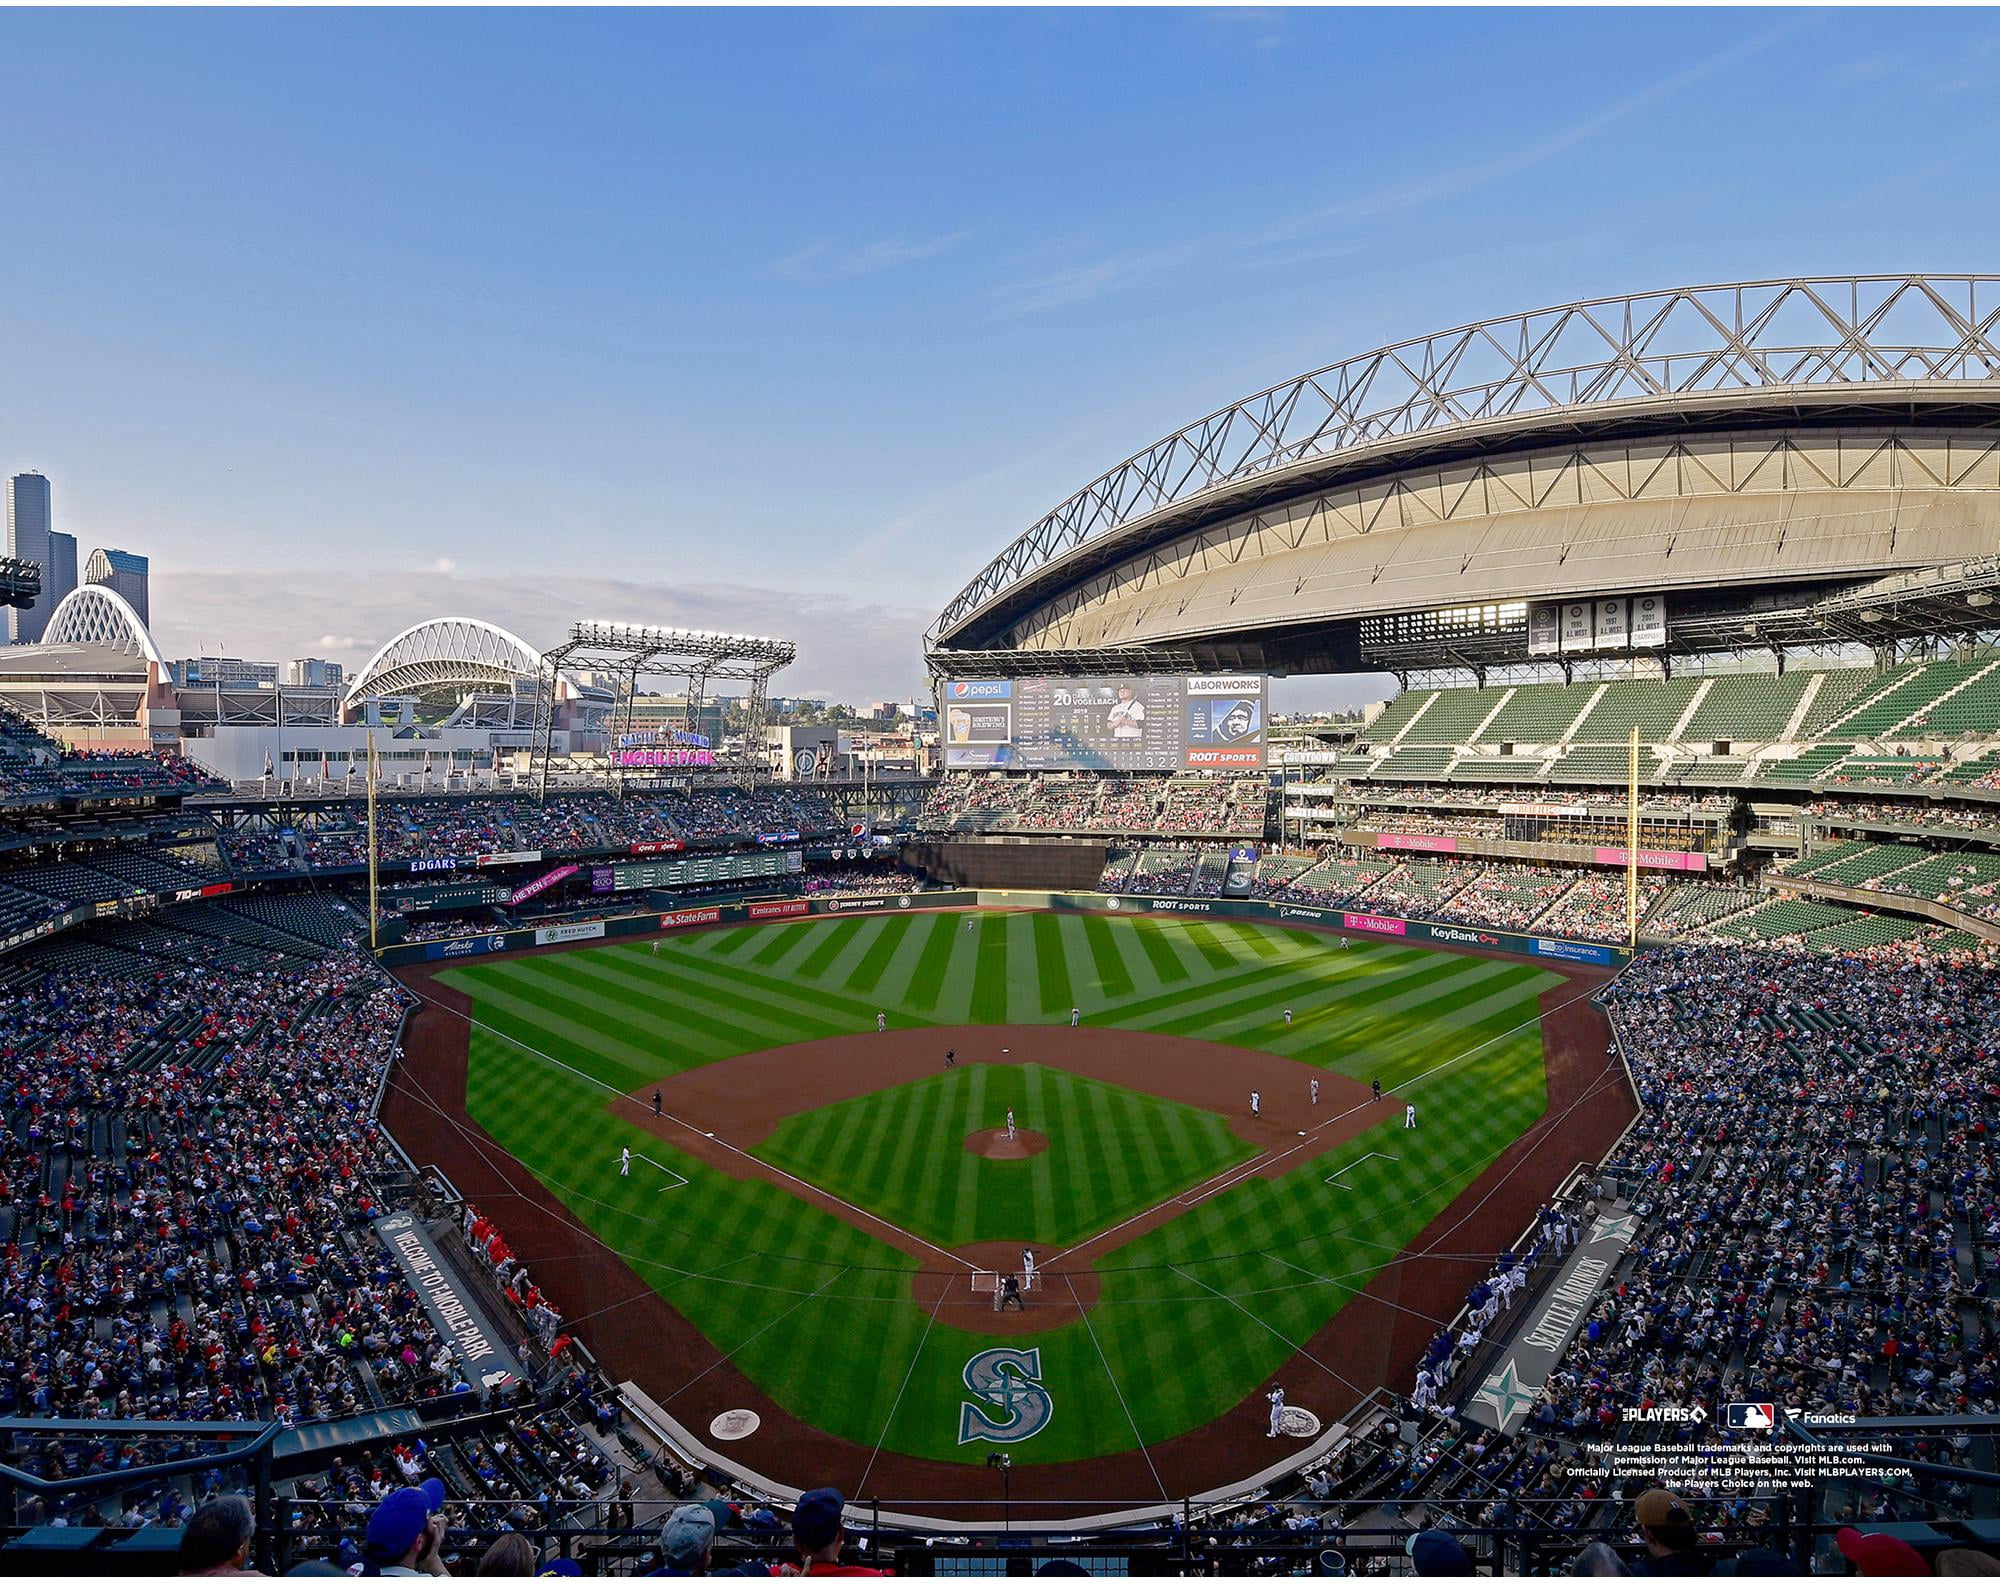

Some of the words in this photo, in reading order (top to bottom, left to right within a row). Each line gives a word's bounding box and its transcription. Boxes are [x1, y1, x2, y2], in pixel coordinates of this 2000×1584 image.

[1574, 629, 1588, 637] WEST
[971, 684, 1002, 696] pepsi
[1188, 680, 1259, 690] LABORWORKS
[1053, 694, 1072, 706] 20
[678, 750, 716, 766] PARK
[1146, 757, 1154, 768] 3
[1158, 757, 1166, 768] 2
[1170, 757, 1178, 768] 2
[1189, 752, 1220, 762] ROOT
[1220, 754, 1257, 762] SPORTS
[636, 779, 650, 789] TRUE
[651, 779, 660, 788] TO
[661, 779, 672, 788] THE
[672, 778, 687, 788] BLUE
[525, 881, 544, 894] PEN
[752, 906, 781, 915] Emirates
[1152, 900, 1178, 909] ROOT
[1178, 903, 1210, 911] SPORTS
[1290, 909, 1322, 918] BOEING
[1431, 926, 1479, 943] KeyBank
[443, 940, 474, 951] Alaska
[1564, 945, 1598, 957] Insurance
[394, 1230, 437, 1275] WELCOME
[420, 1270, 444, 1287] TO
[427, 1282, 474, 1332] T-MOBILE
[1523, 1301, 1580, 1353] SEATTLE
[1552, 1256, 1609, 1307] MARINERS
[456, 1324, 494, 1362] PARK
